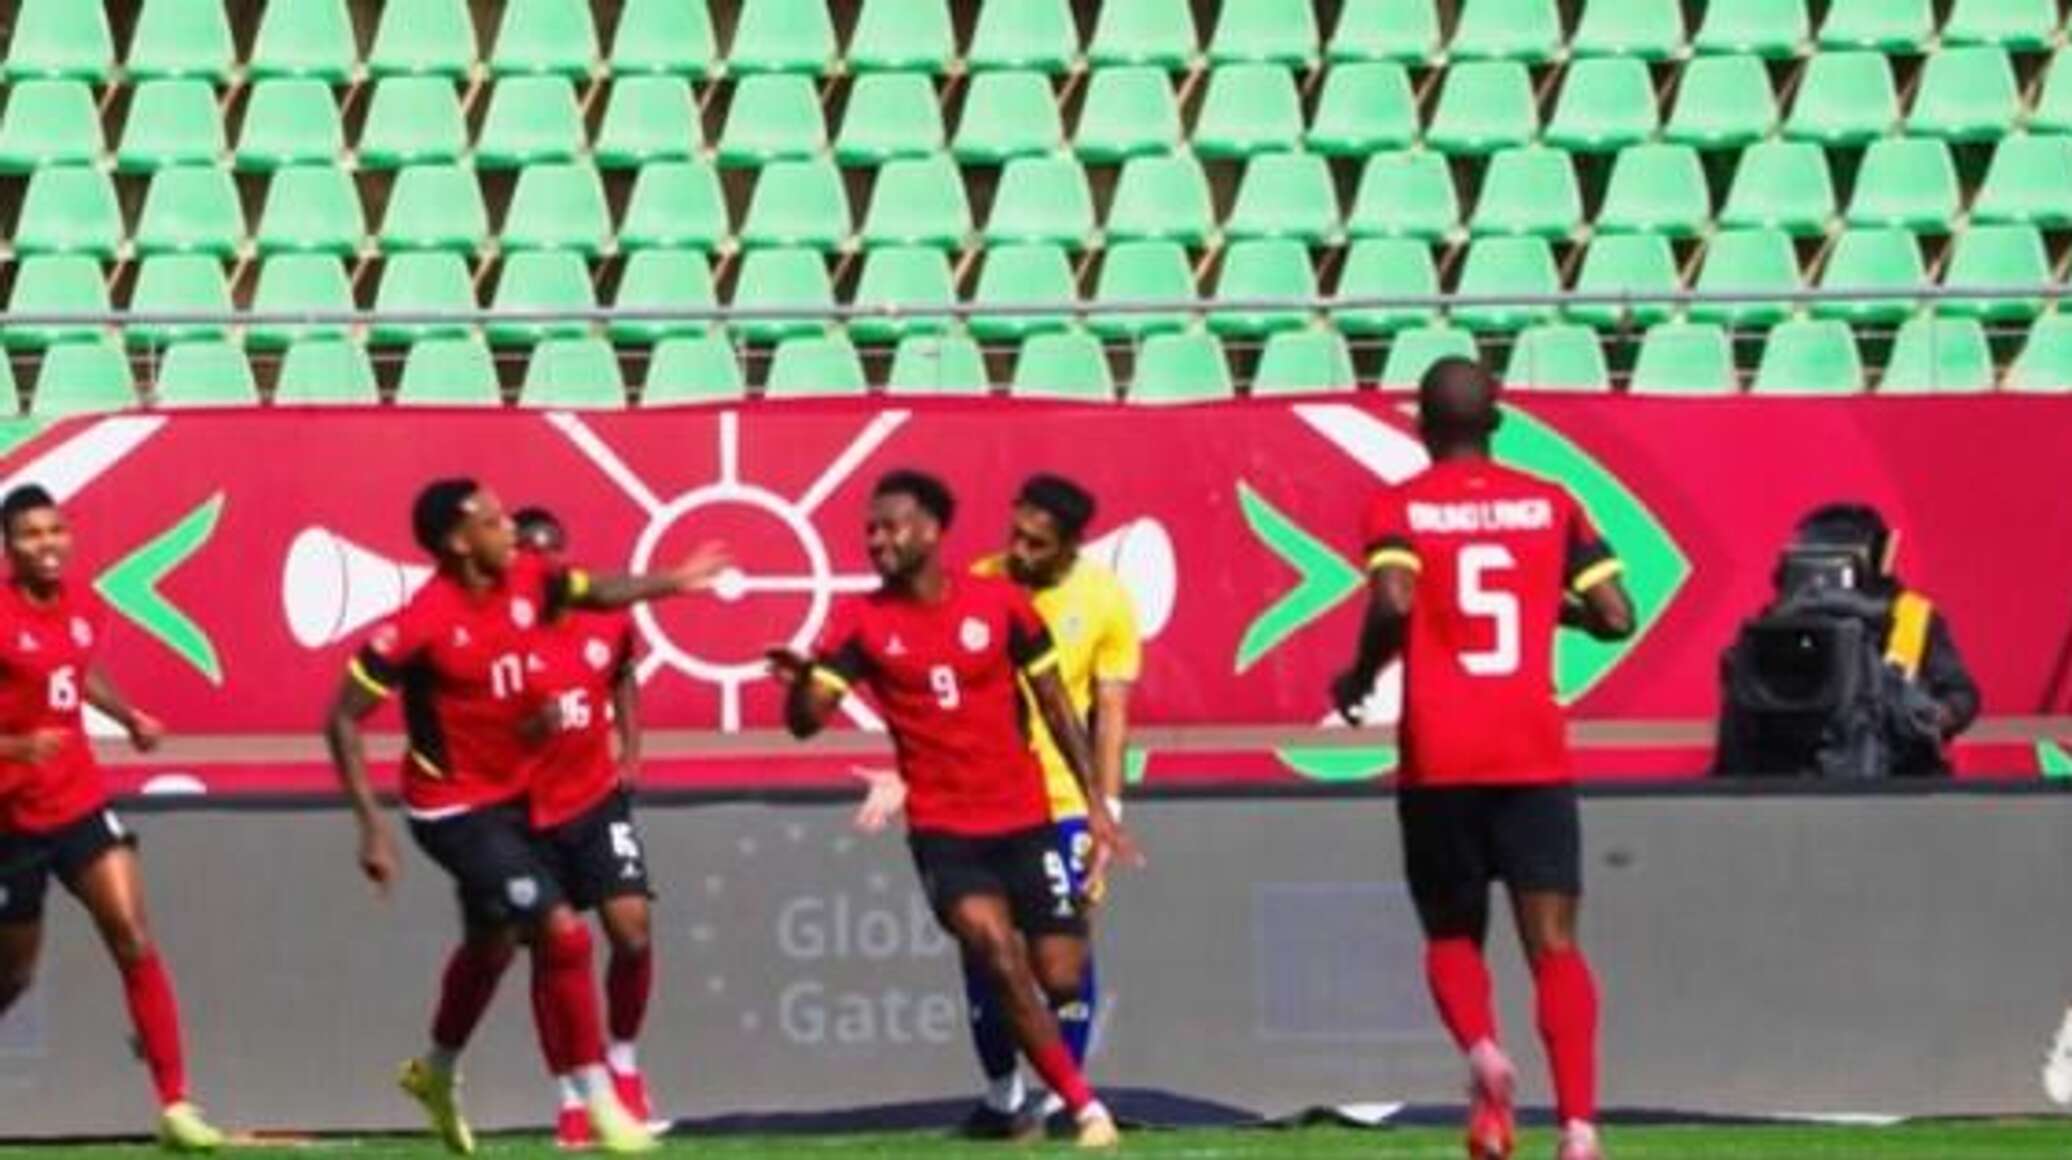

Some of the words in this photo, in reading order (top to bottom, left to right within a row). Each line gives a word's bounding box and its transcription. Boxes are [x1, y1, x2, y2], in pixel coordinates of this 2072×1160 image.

[1458, 541, 1521, 676] 5
[491, 652, 522, 698] 17
[930, 664, 960, 709] 9
[1042, 850, 1070, 895] 9
[777, 893, 948, 958] Glob
